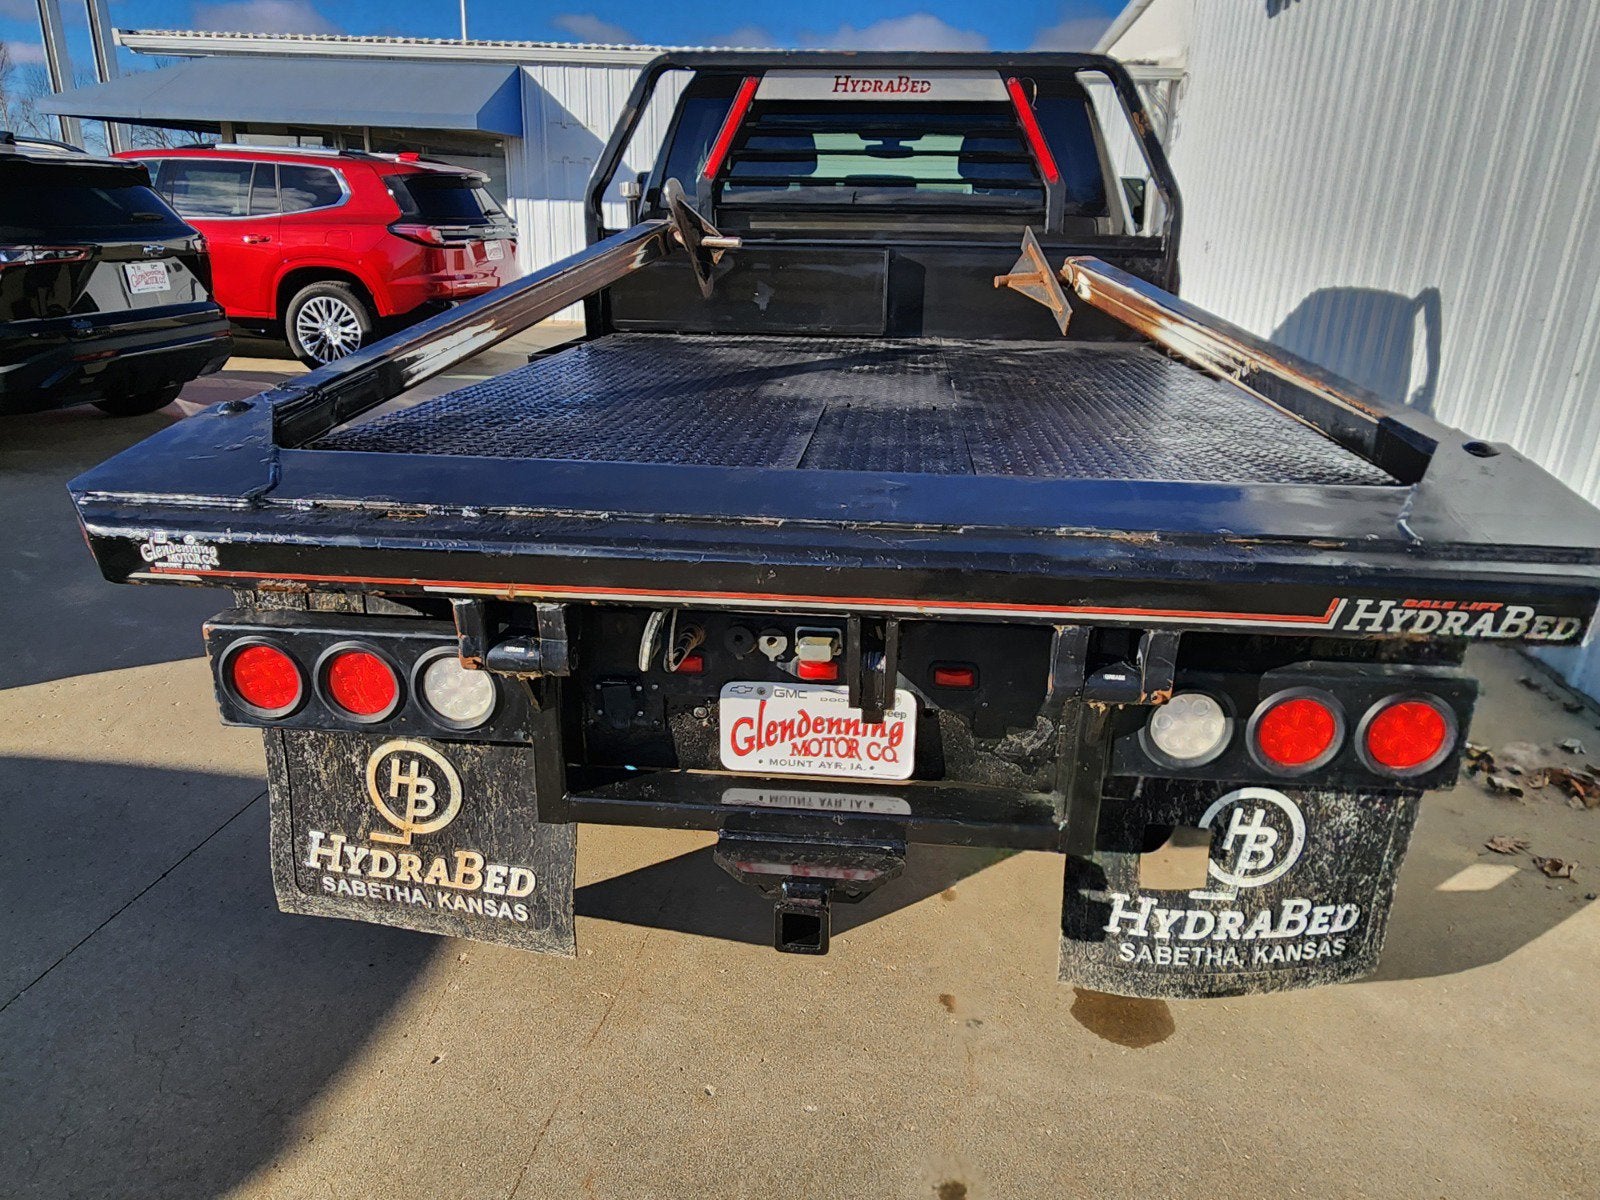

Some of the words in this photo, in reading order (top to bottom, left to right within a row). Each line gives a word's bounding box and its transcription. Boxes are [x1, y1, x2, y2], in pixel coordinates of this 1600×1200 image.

[1343, 597, 1582, 641] HYDRABED
[773, 688, 808, 699] GMC
[730, 699, 905, 756] Glendenning
[789, 737, 863, 761] MOTOR
[769, 758, 813, 768] MOUNT
[818, 761, 846, 771] AYR,
[305, 830, 537, 898] HYDRABED
[322, 876, 433, 909] SABETHA,
[437, 891, 530, 922] KANSAS
[1103, 892, 1361, 941] HYDRABED
[1119, 942, 1245, 967] SABETHA,
[1252, 938, 1348, 964] KANSAS
